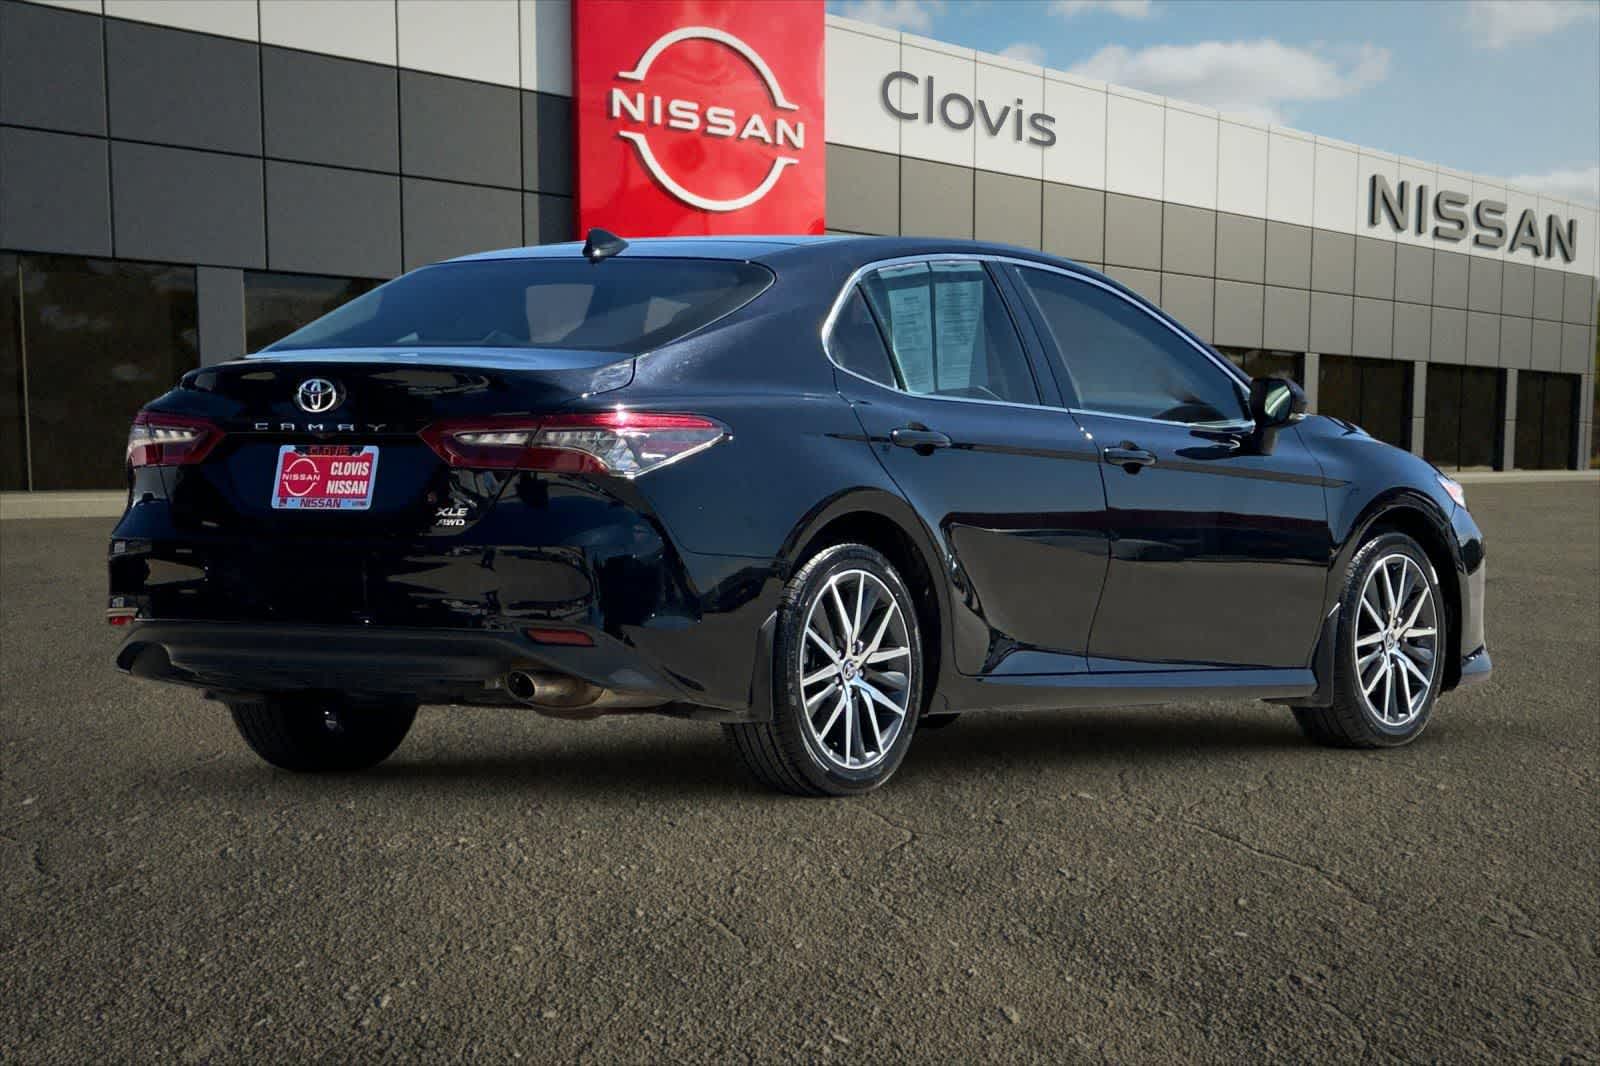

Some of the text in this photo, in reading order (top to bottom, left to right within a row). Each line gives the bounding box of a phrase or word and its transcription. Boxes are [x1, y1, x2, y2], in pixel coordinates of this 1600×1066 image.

[881, 70, 1057, 147] Clovis
[611, 88, 806, 149] NISSAN
[1368, 173, 1577, 263] NISSAN
[254, 422, 387, 432] CAMRY
[330, 461, 370, 476] CLOVIS
[282, 473, 320, 481] NISSAN
[326, 480, 368, 494] NISSAN
[300, 498, 341, 508] NISSAN
[435, 507, 469, 517] XLE
[436, 518, 465, 526] AWD
